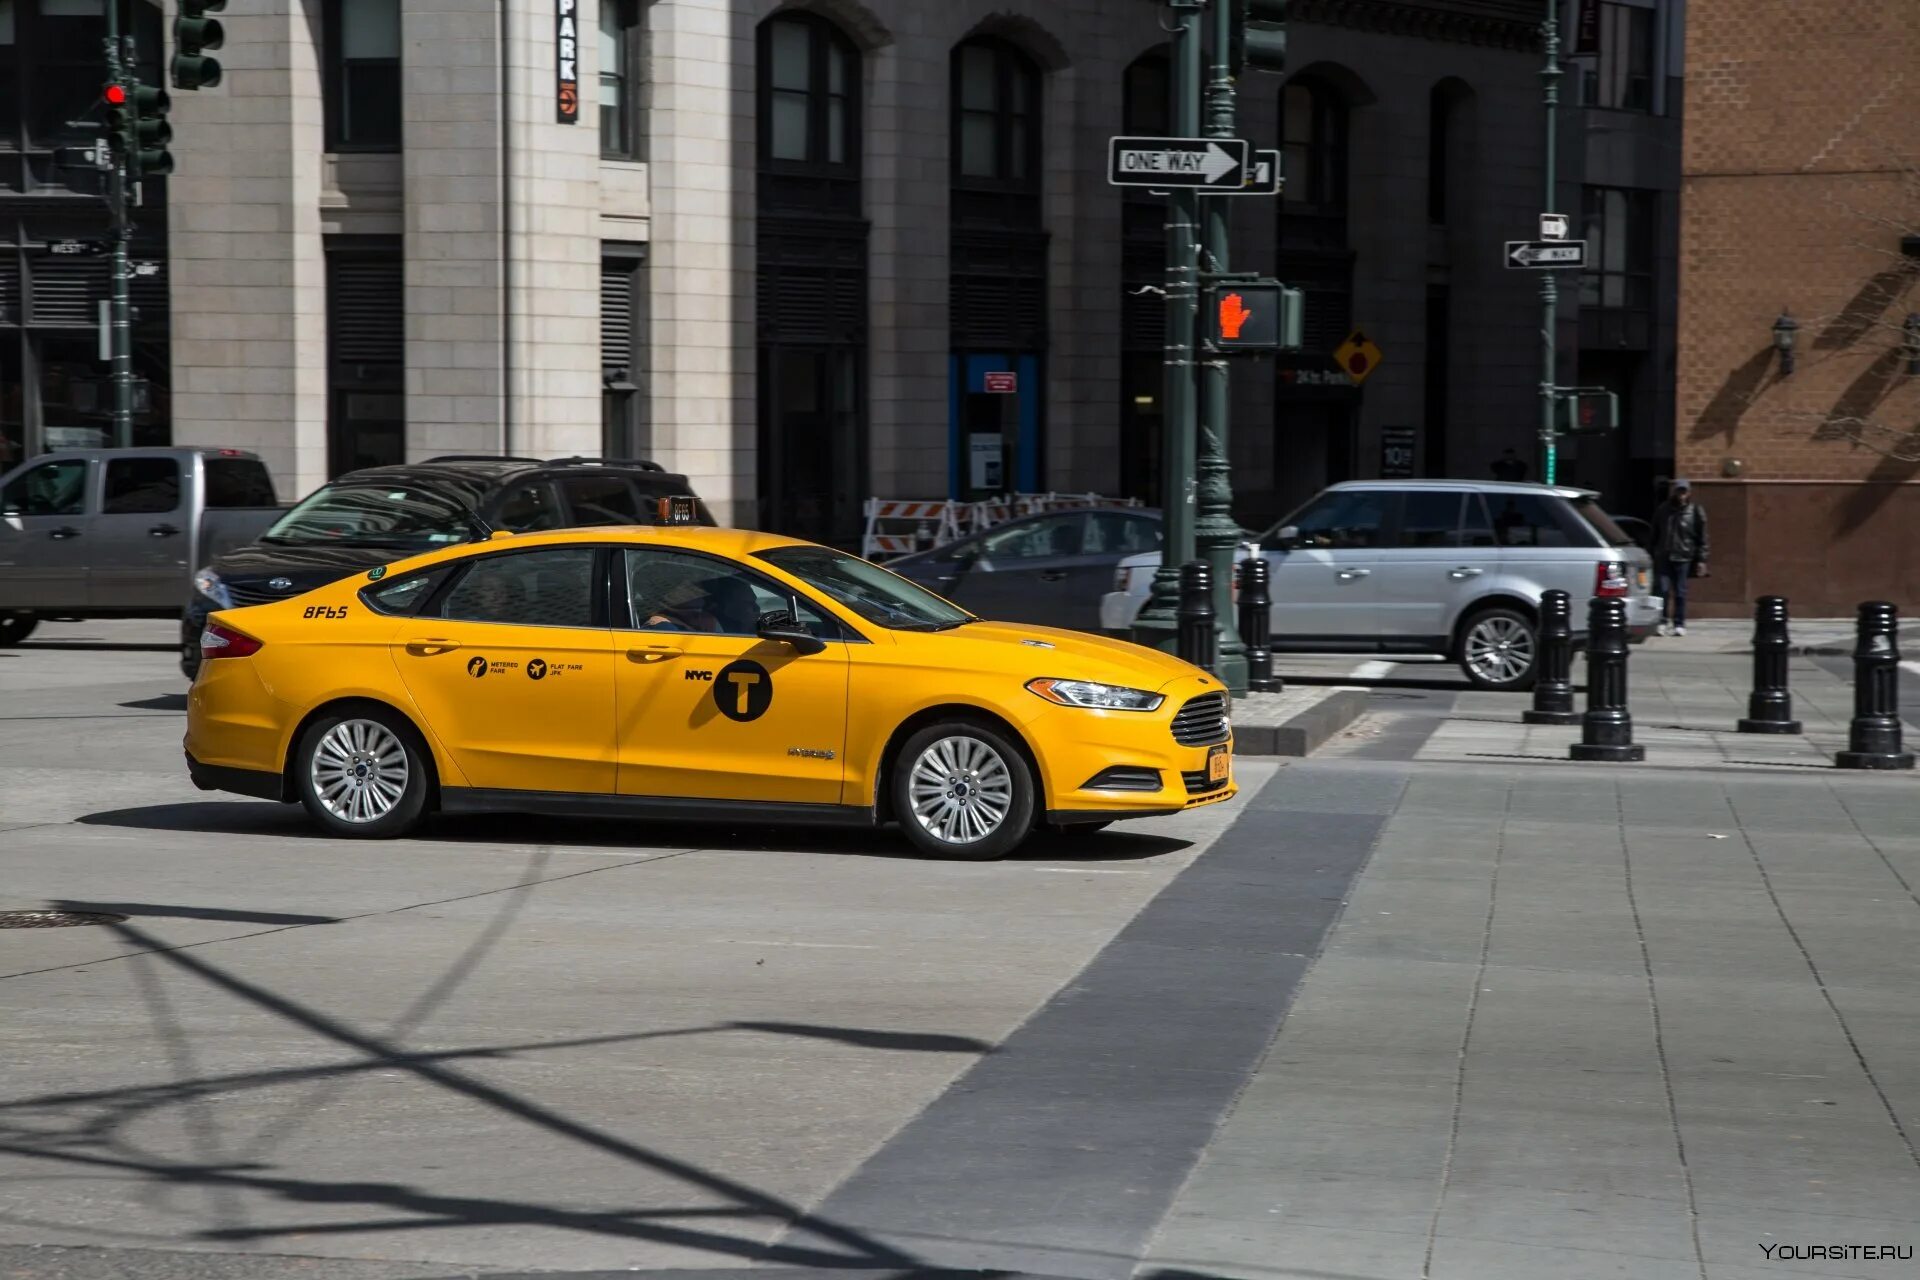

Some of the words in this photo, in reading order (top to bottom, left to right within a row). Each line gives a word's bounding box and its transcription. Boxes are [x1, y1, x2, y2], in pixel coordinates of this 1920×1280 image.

[559, 0, 577, 80] PARK
[1125, 152, 1161, 171] ONE
[1168, 152, 1205, 172] WAY
[1519, 249, 1540, 261] ONE
[1552, 250, 1574, 260] WAY
[490, 661, 519, 669] METERED
[684, 669, 713, 681] NYC
[727, 671, 760, 714] T
